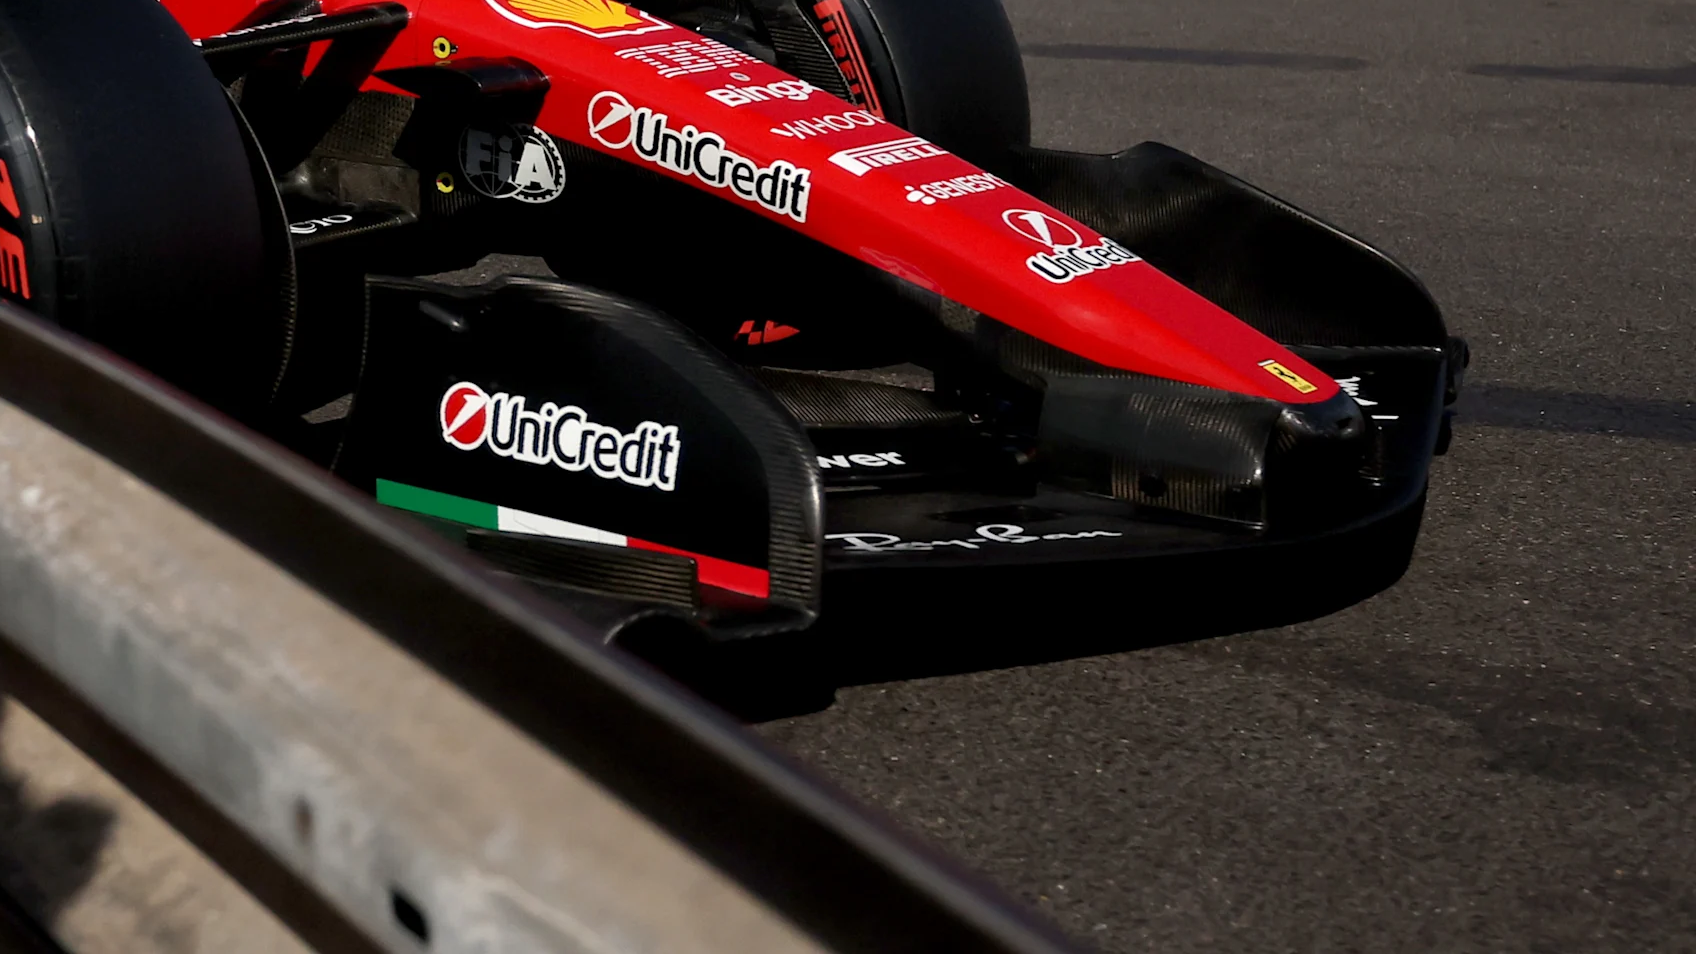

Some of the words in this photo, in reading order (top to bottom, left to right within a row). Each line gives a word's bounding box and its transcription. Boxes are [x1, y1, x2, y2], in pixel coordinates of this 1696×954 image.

[634, 111, 806, 215] UniCredit
[828, 136, 952, 178] PIRELL
[490, 398, 675, 486] UniCredit
